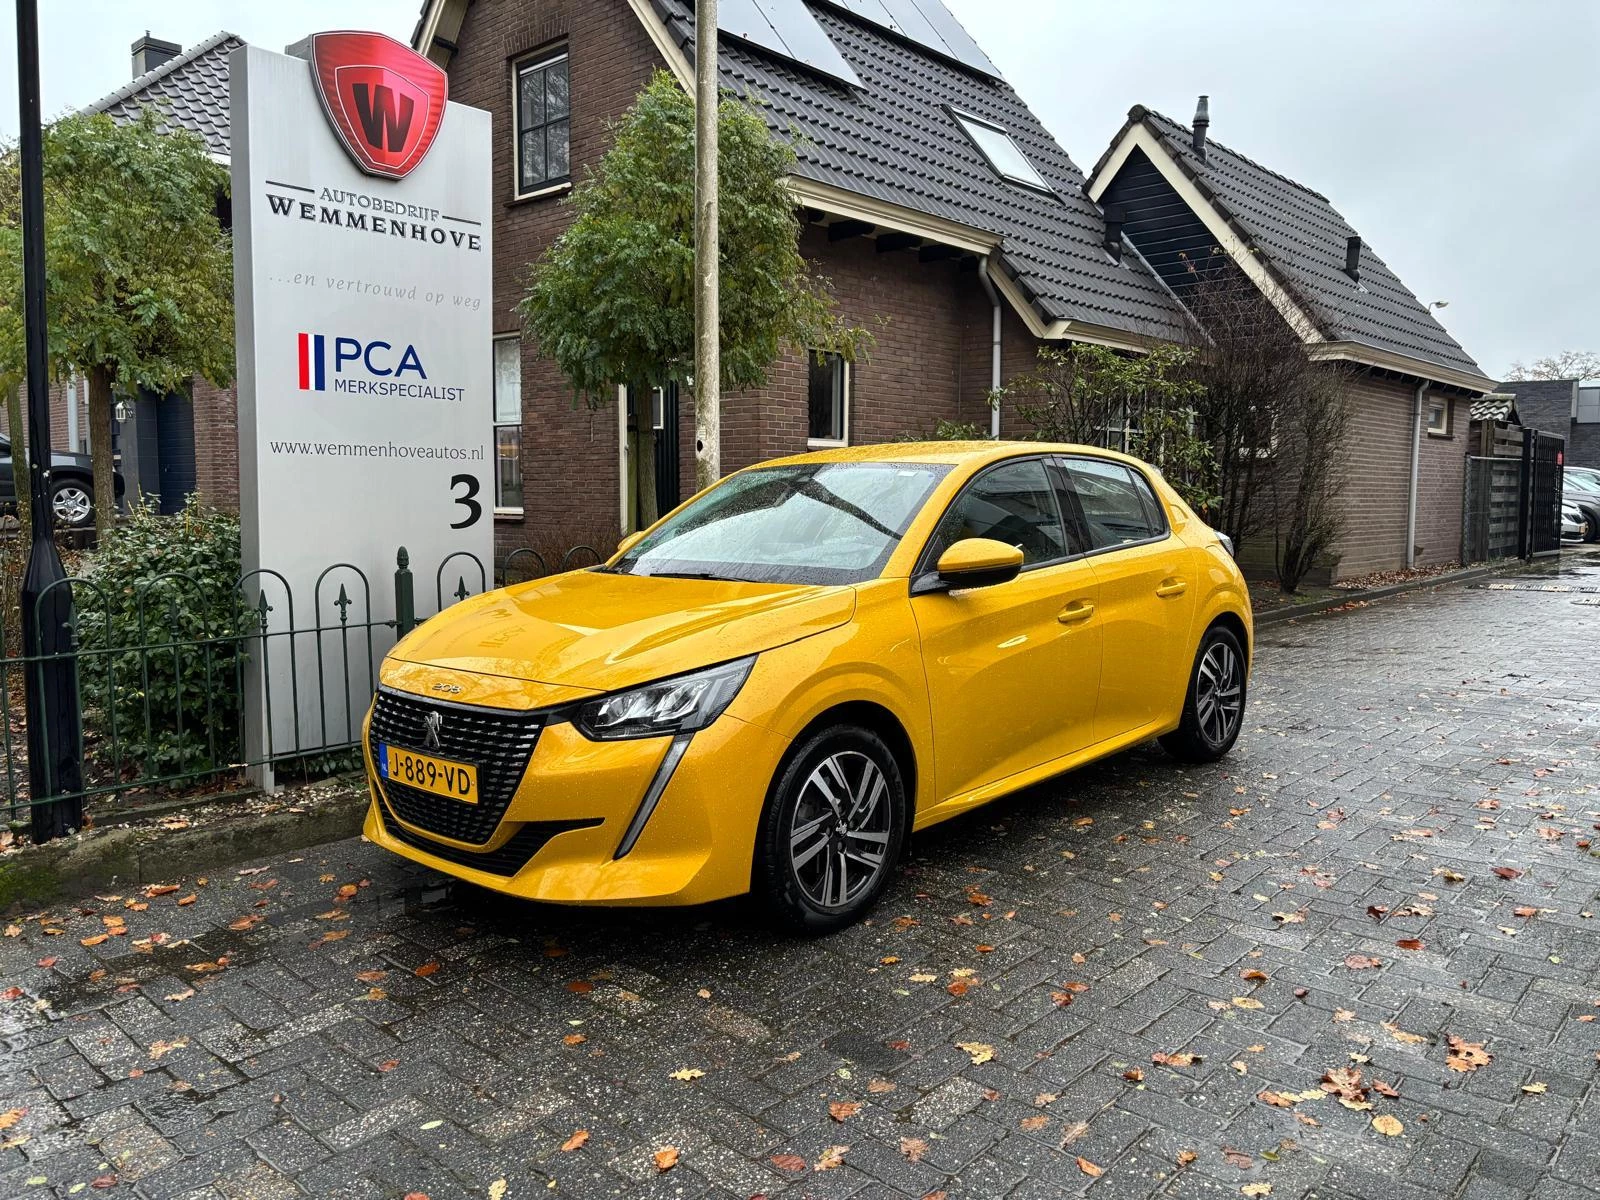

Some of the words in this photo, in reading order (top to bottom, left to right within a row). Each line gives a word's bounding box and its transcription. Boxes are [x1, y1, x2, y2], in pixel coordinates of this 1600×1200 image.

[352, 82, 415, 153] W
[266, 193, 482, 252] WEMMENHOVE
[320, 187, 440, 222] AUTOBEDRIJF
[326, 277, 417, 301] vertrouwd
[425, 291, 444, 306] op
[453, 295, 481, 312] weg
[335, 336, 428, 380] PCA
[334, 378, 466, 402] MERKSPECIALIST
[269, 440, 485, 461] www.wemmenhoveautos.nl
[449, 473, 483, 530] 3
[432, 682, 462, 695] 208
[392, 752, 471, 795] J-889-VD
